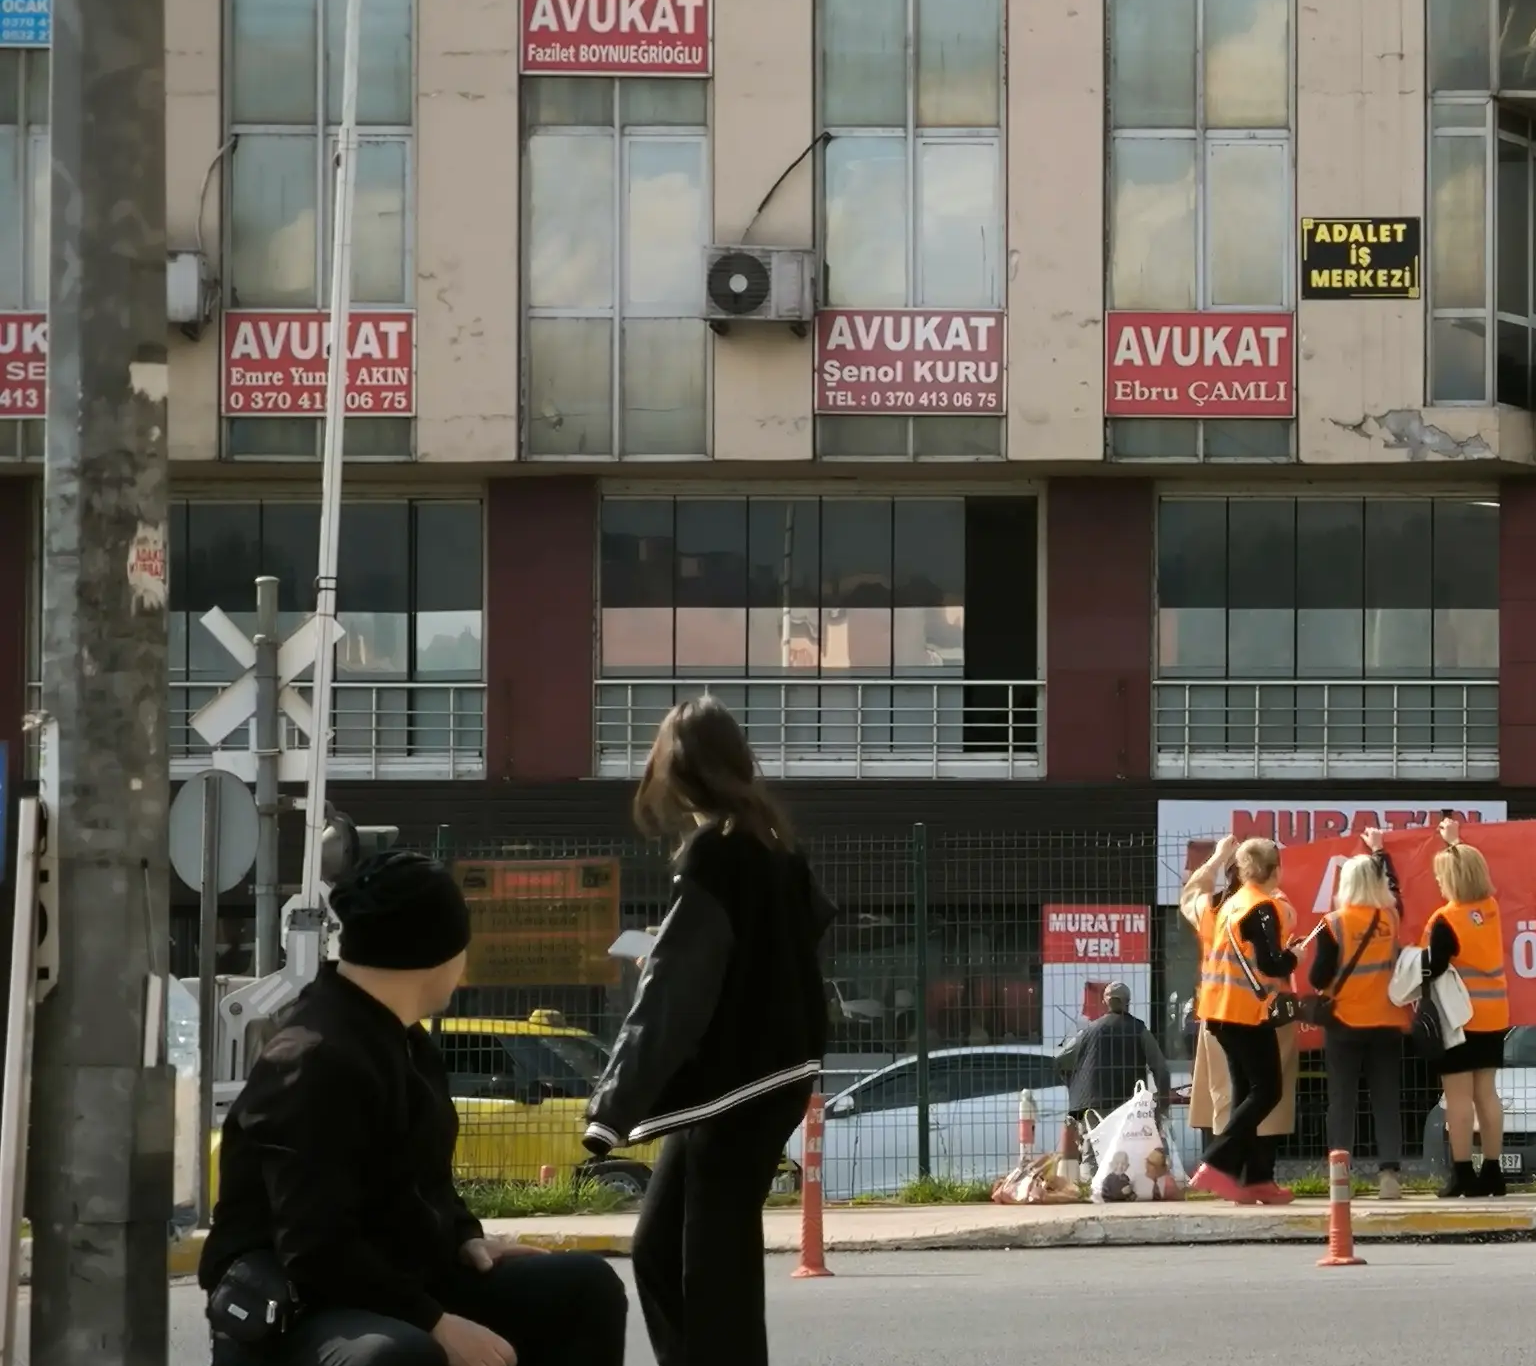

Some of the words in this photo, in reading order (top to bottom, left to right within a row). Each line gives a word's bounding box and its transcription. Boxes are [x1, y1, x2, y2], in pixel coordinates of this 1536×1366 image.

[528, 41, 576, 63] Fazilet
[580, 40, 703, 65] BOYNUEĞRİOĞLU
[1315, 223, 1407, 243] ADALET
[1350, 243, 1372, 267] İŞ
[1310, 266, 1412, 288] MERKEZİ
[826, 316, 996, 351] AVUKAT
[1113, 326, 1288, 367] AVUKAT
[231, 367, 284, 386] Emre
[290, 367, 349, 387] Yuns
[355, 367, 409, 386] AKIN
[824, 359, 904, 387] Şenol
[914, 361, 999, 383] KURU
[230, 393, 244, 409] 0
[251, 393, 291, 409] 370
[345, 393, 373, 409] 06
[381, 393, 408, 409] 75
[826, 392, 857, 406] TEL
[871, 393, 880, 407] 0
[886, 393, 914, 408] 370
[920, 393, 949, 408] 413
[954, 393, 973, 407] 06
[978, 393, 997, 408] 75
[1114, 380, 1178, 401] Ebru
[1188, 381, 1288, 406] ÇAMLI
[1048, 913, 1147, 934] MURAT'IN
[1074, 931, 1121, 958] YERİ
